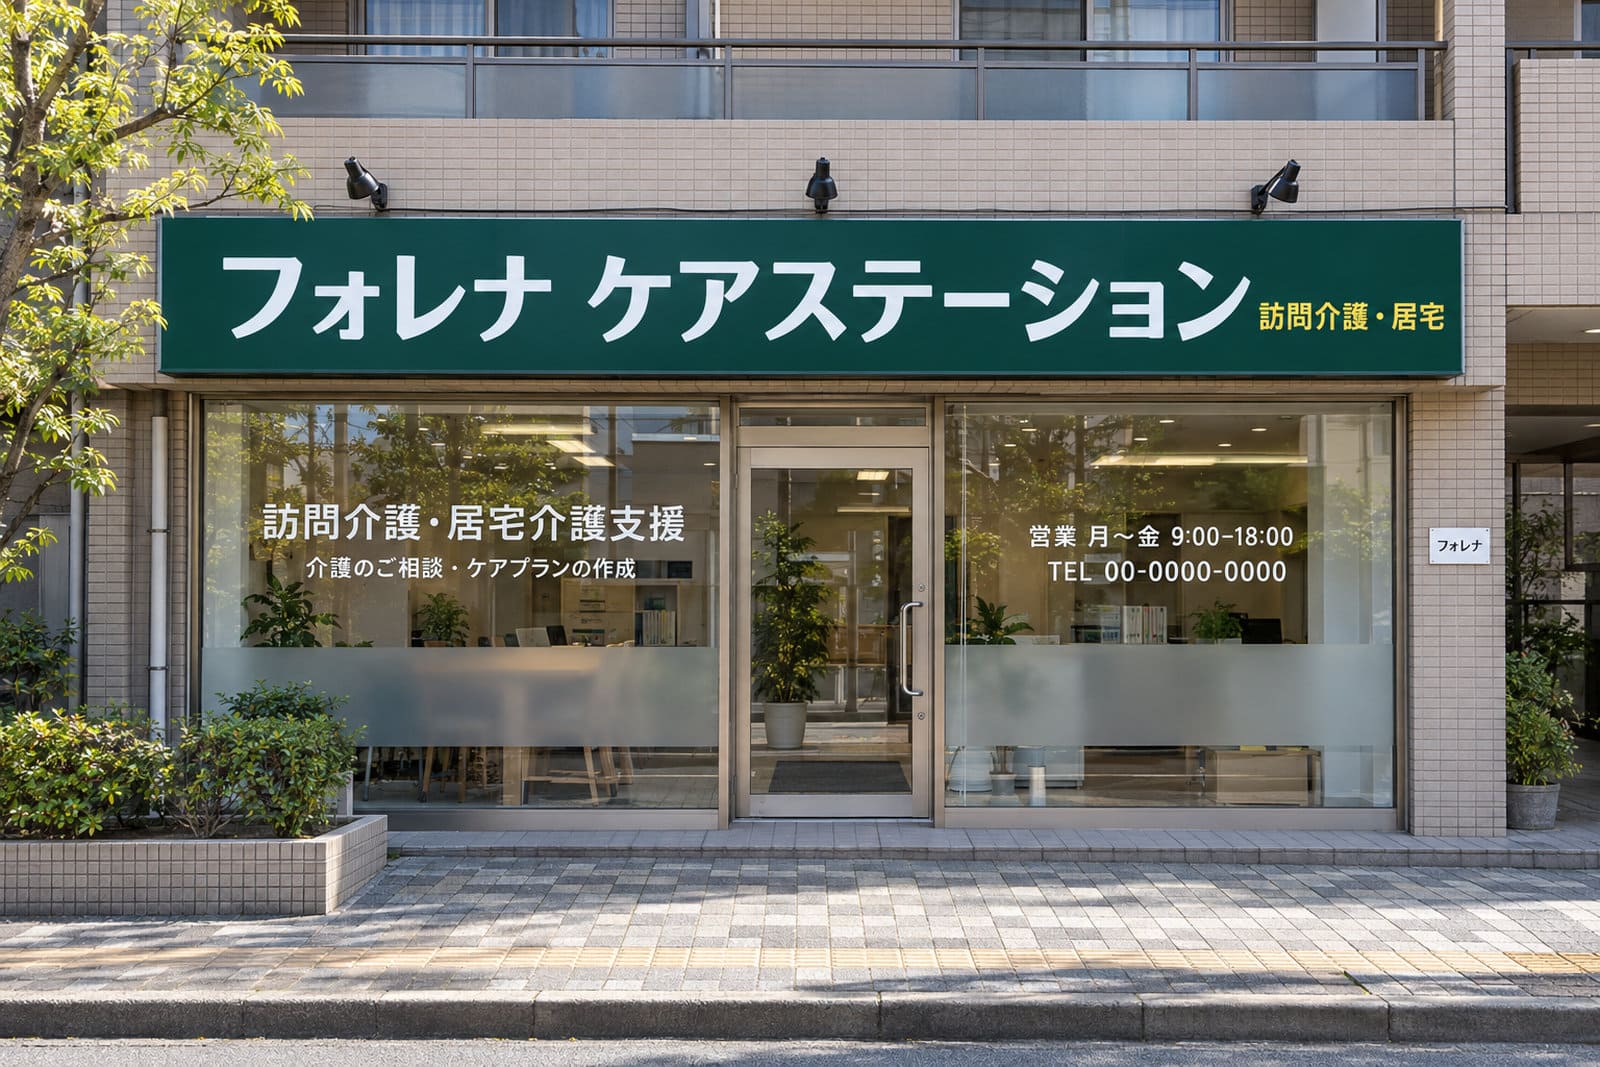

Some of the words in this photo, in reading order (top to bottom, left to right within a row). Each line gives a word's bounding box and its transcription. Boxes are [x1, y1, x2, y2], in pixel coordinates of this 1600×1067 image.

[222, 255, 552, 342] フォレナ
[587, 255, 1251, 343] ケアステーション
[1258, 301, 1445, 331] 訪問介護・居宅
[262, 503, 684, 542] 訪問介護・居宅介護支援
[1029, 524, 1076, 548] 営業
[1437, 539, 1483, 552] フォレナ
[306, 556, 636, 579] 介護のご相談・ケアプランの作成
[1047, 561, 1092, 582] TEL
[1104, 560, 1287, 582] 00-0000-0000
